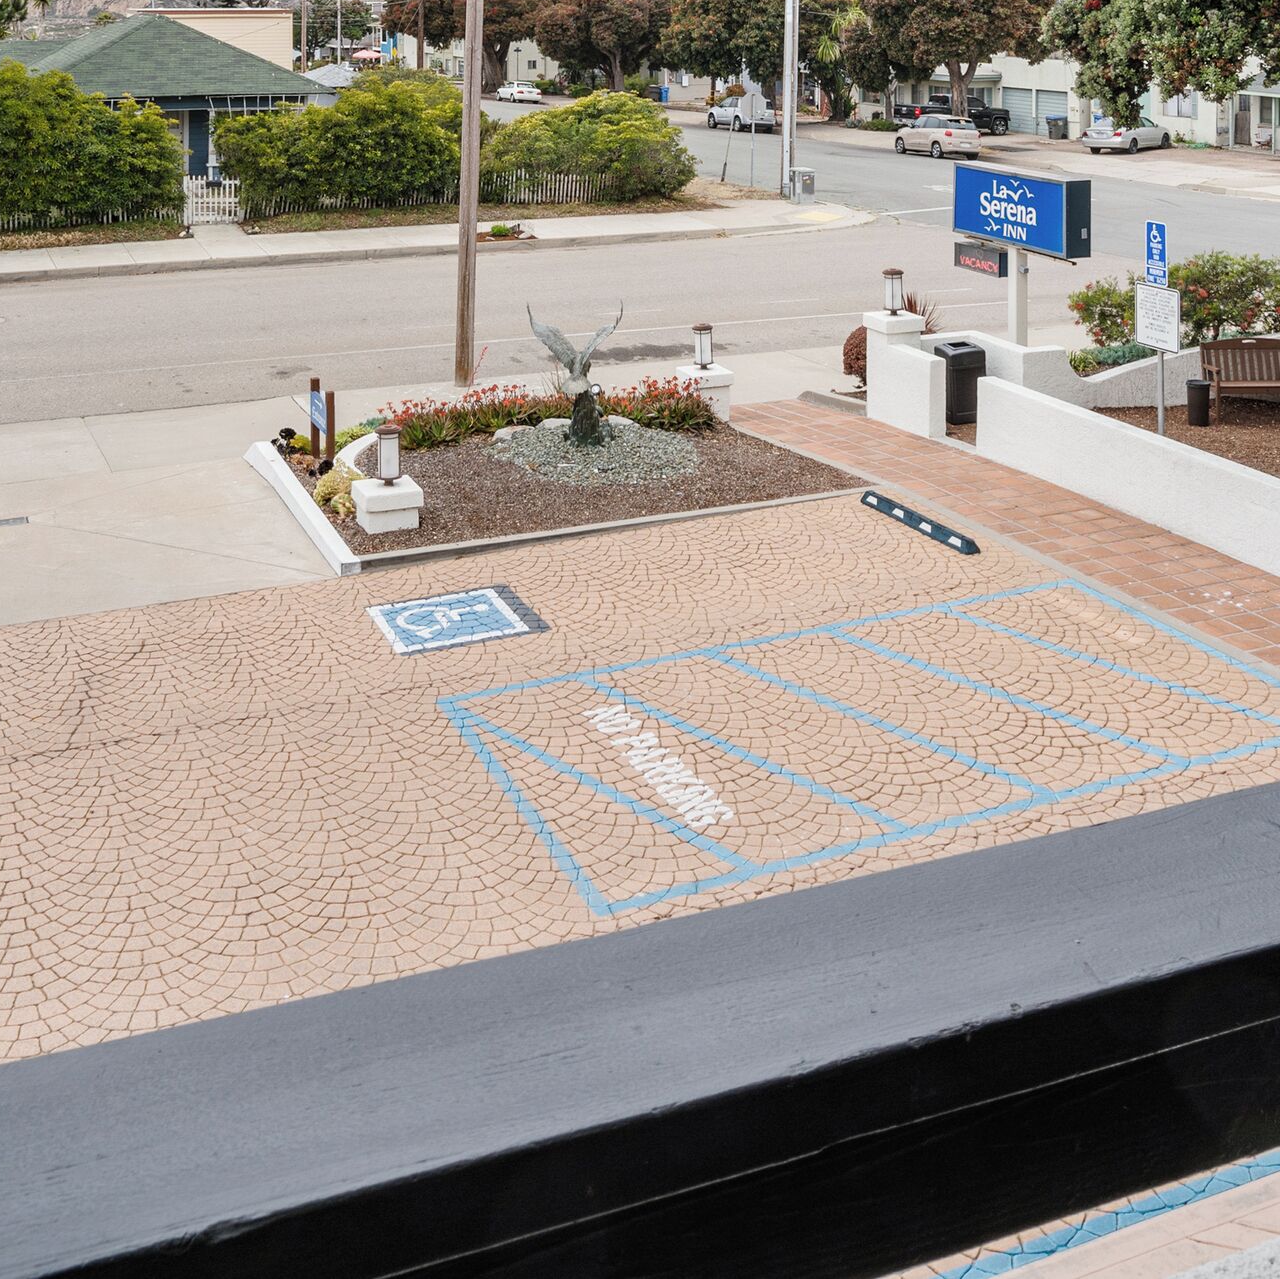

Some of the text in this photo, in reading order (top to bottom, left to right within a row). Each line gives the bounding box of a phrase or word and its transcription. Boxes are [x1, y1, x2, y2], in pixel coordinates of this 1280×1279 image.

[992, 180, 1008, 199] La
[980, 192, 1037, 226] Serena
[1003, 223, 1027, 241] INN
[960, 255, 999, 273] VACANCY
[581, 704, 734, 828] NO PARKING
